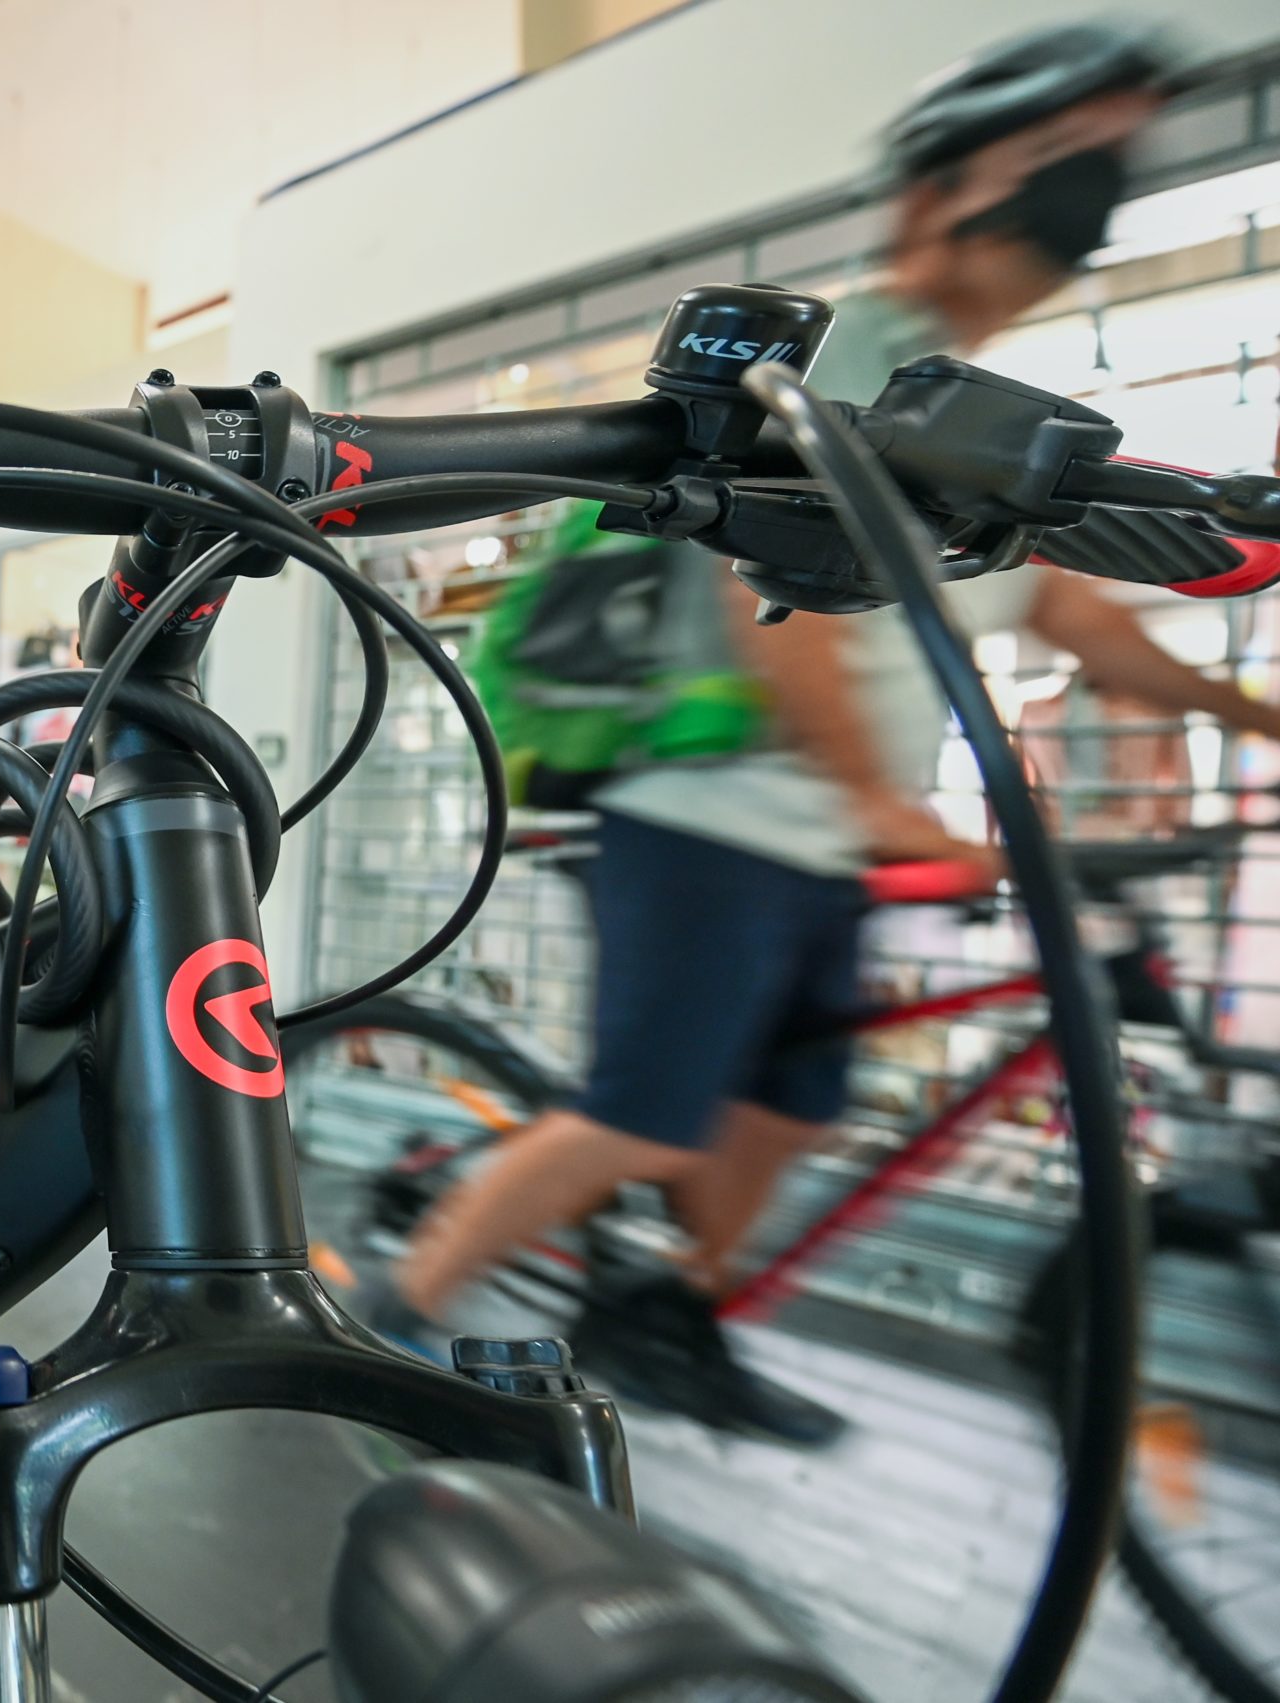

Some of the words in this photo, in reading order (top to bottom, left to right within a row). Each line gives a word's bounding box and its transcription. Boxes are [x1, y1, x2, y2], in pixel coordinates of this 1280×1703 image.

[678, 333, 761, 361] KLS
[228, 429, 236, 439] 5
[227, 449, 239, 460] 10
[161, 605, 193, 635] ACTIVE
